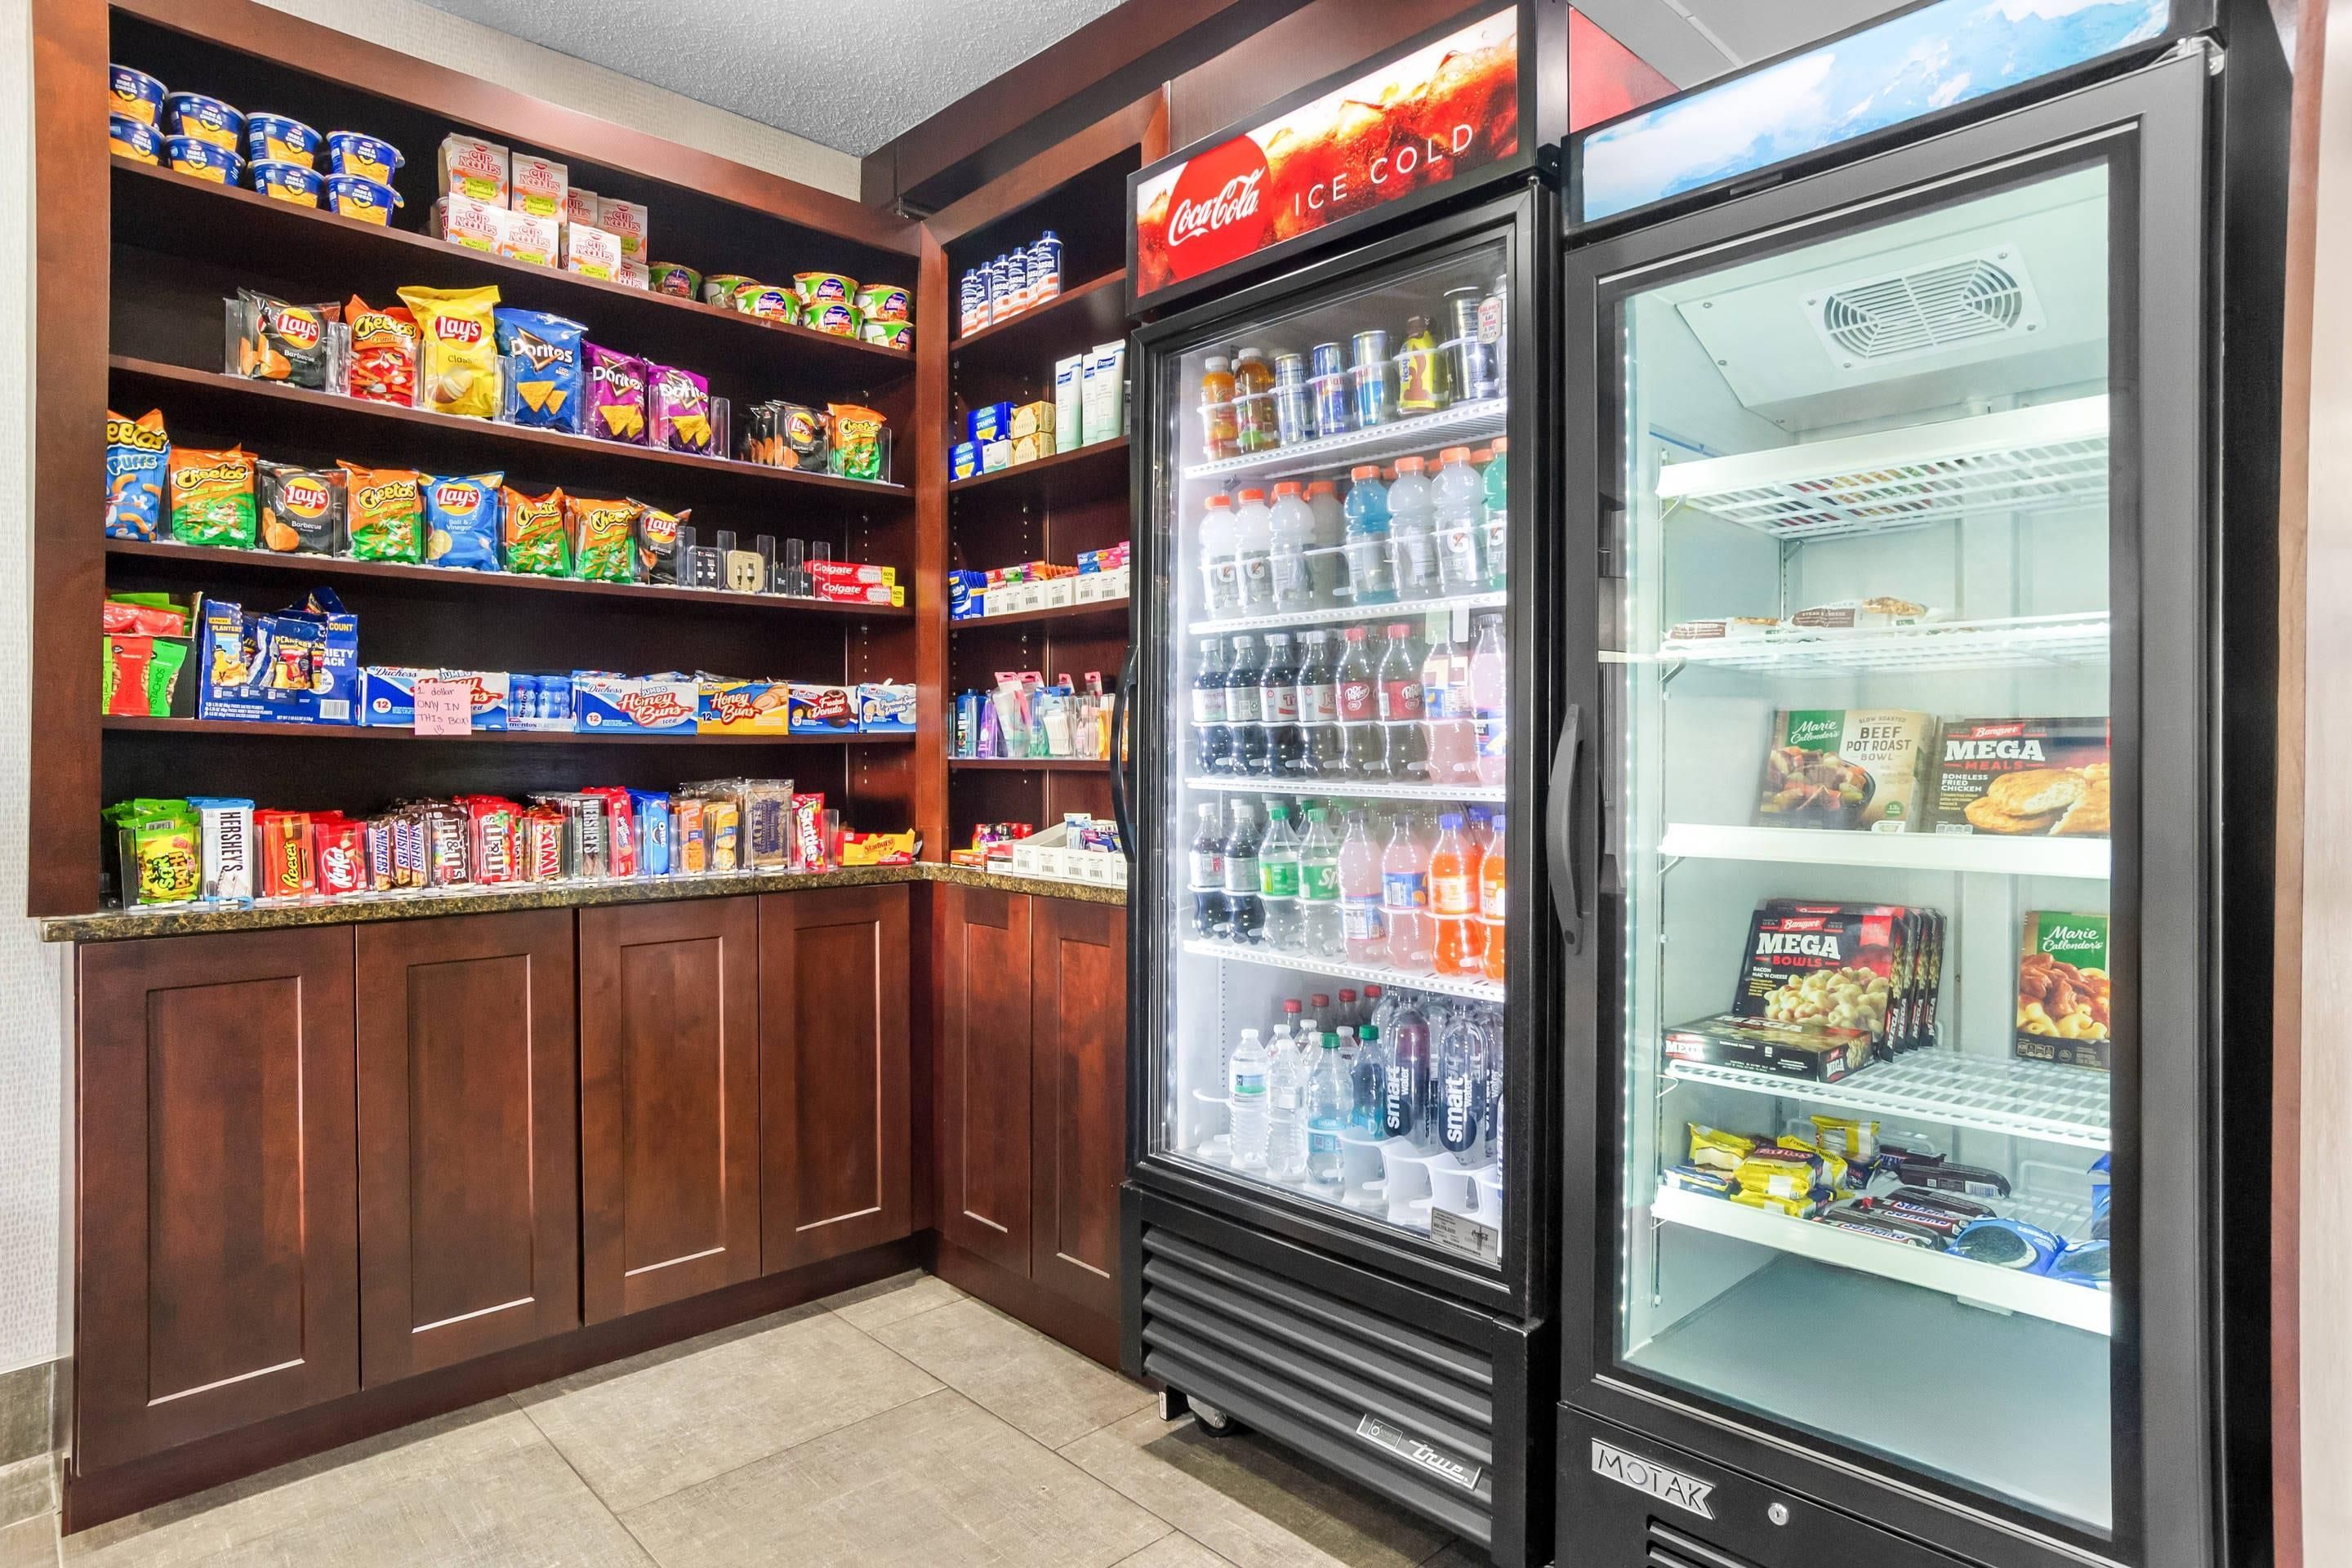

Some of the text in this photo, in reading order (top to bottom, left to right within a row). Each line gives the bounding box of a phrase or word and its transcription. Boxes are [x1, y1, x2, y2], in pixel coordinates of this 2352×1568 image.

[469, 151, 493, 165] CUP
[459, 156, 501, 176] NOODLES
[1294, 123, 1474, 217] ICE COLD
[529, 168, 553, 180] CUP
[519, 174, 561, 191] NOODLES
[568, 198, 584, 212] UP
[466, 211, 489, 224] CUP
[612, 210, 635, 223] CUP
[455, 216, 498, 236] NOODLES
[519, 226, 543, 238] CUP
[604, 217, 642, 232] NOODLES
[509, 232, 550, 249] NOODLES
[586, 238, 608, 253] CUP
[575, 245, 614, 263] NOODLES
[278, 314, 318, 341] Lay's
[352, 315, 416, 338] Cheetos
[436, 314, 482, 343] Lay's
[283, 350, 315, 363] Barbecue
[510, 337, 574, 365] Doritos
[840, 419, 882, 437] Cheetos
[976, 416, 996, 430] TAMPAX
[106, 420, 169, 451] eetos
[955, 452, 974, 466] TAMPAX
[175, 463, 248, 489] Cheetos
[287, 484, 327, 509] Lay's
[359, 482, 416, 510] Cheetos
[438, 487, 479, 507] Lay's
[291, 519, 323, 531] Barbecue
[446, 523, 473, 532] Vinegar
[648, 517, 678, 539] Lay's
[813, 562, 854, 575] Colgate
[822, 582, 862, 595] Colgate
[212, 625, 243, 633] PLANTERS
[328, 622, 354, 632] COUNT
[323, 657, 345, 667] ACK
[375, 666, 418, 679] Duchess
[439, 670, 473, 680] JUMBO
[417, 686, 454, 697] 1 dollar
[587, 684, 623, 694] Duchess
[642, 686, 668, 697] JUMBO
[701, 684, 722, 693] Duchess
[792, 690, 818, 700] Duchess
[864, 688, 888, 697] Duchess
[1347, 688, 1368, 702] Pepper
[1352, 685, 1362, 693] Dr
[376, 700, 390, 709] 12
[443, 702, 461, 711] IN
[617, 693, 673, 710] Honey
[710, 691, 750, 710] Honey
[819, 696, 845, 707] Frosted
[880, 698, 904, 709] Powdered
[635, 705, 683, 724] Buns
[702, 711, 713, 722] 12
[721, 703, 755, 721] Buns
[812, 705, 844, 719] Donuts
[884, 705, 906, 715] Donuts
[1792, 719, 1838, 734] Marie
[1860, 726, 1902, 740] BEEF
[1976, 726, 2020, 737] Banquet
[1790, 730, 1840, 745] Callender's
[1846, 739, 1913, 752] POT ROAST
[1944, 739, 2046, 762] MEGA
[1860, 752, 1895, 761] BOWL
[1964, 760, 2024, 771] MEALS
[1942, 773, 1989, 781] BONELESS
[220, 811, 244, 872] HERSHEY'S
[397, 818, 409, 867] SATISFIES
[657, 822, 667, 848] OREO
[798, 807, 817, 863] Skittles
[376, 828, 389, 874] SNICKERS
[410, 822, 421, 869] SATISFIES
[539, 830, 559, 875] TWIX
[864, 838, 895, 853] Starburst
[158, 856, 174, 891] SOUR
[174, 851, 192, 889] PATCH
[1783, 919, 1821, 930] Banquet
[2043, 925, 2099, 941] Marie
[1755, 933, 1842, 960] MEGA
[2042, 939, 2104, 952] Callender's
[1772, 955, 1823, 968] BOWLS
[1898, 998, 1907, 1040] MEGA
[1913, 999, 1923, 1040] MEGA
[1927, 997, 1936, 1036] MEGA
[1886, 1008, 1900, 1049] MEGA
[1826, 1058, 1845, 1079] MEGA
[1400, 1067, 1410, 1096] water
[1491, 1069, 1499, 1098] water
[1385, 1065, 1401, 1129] smart
[1463, 1079, 1472, 1107] water
[1446, 1074, 1465, 1143] smart
[1788, 1138, 1818, 1152] Premium
[1818, 1148, 1840, 1163] Vanilla
[1844, 1223, 1907, 1240] SNICKERS
[1409, 1439, 1466, 1481] true
[1598, 1448, 1709, 1513] MOTAK
